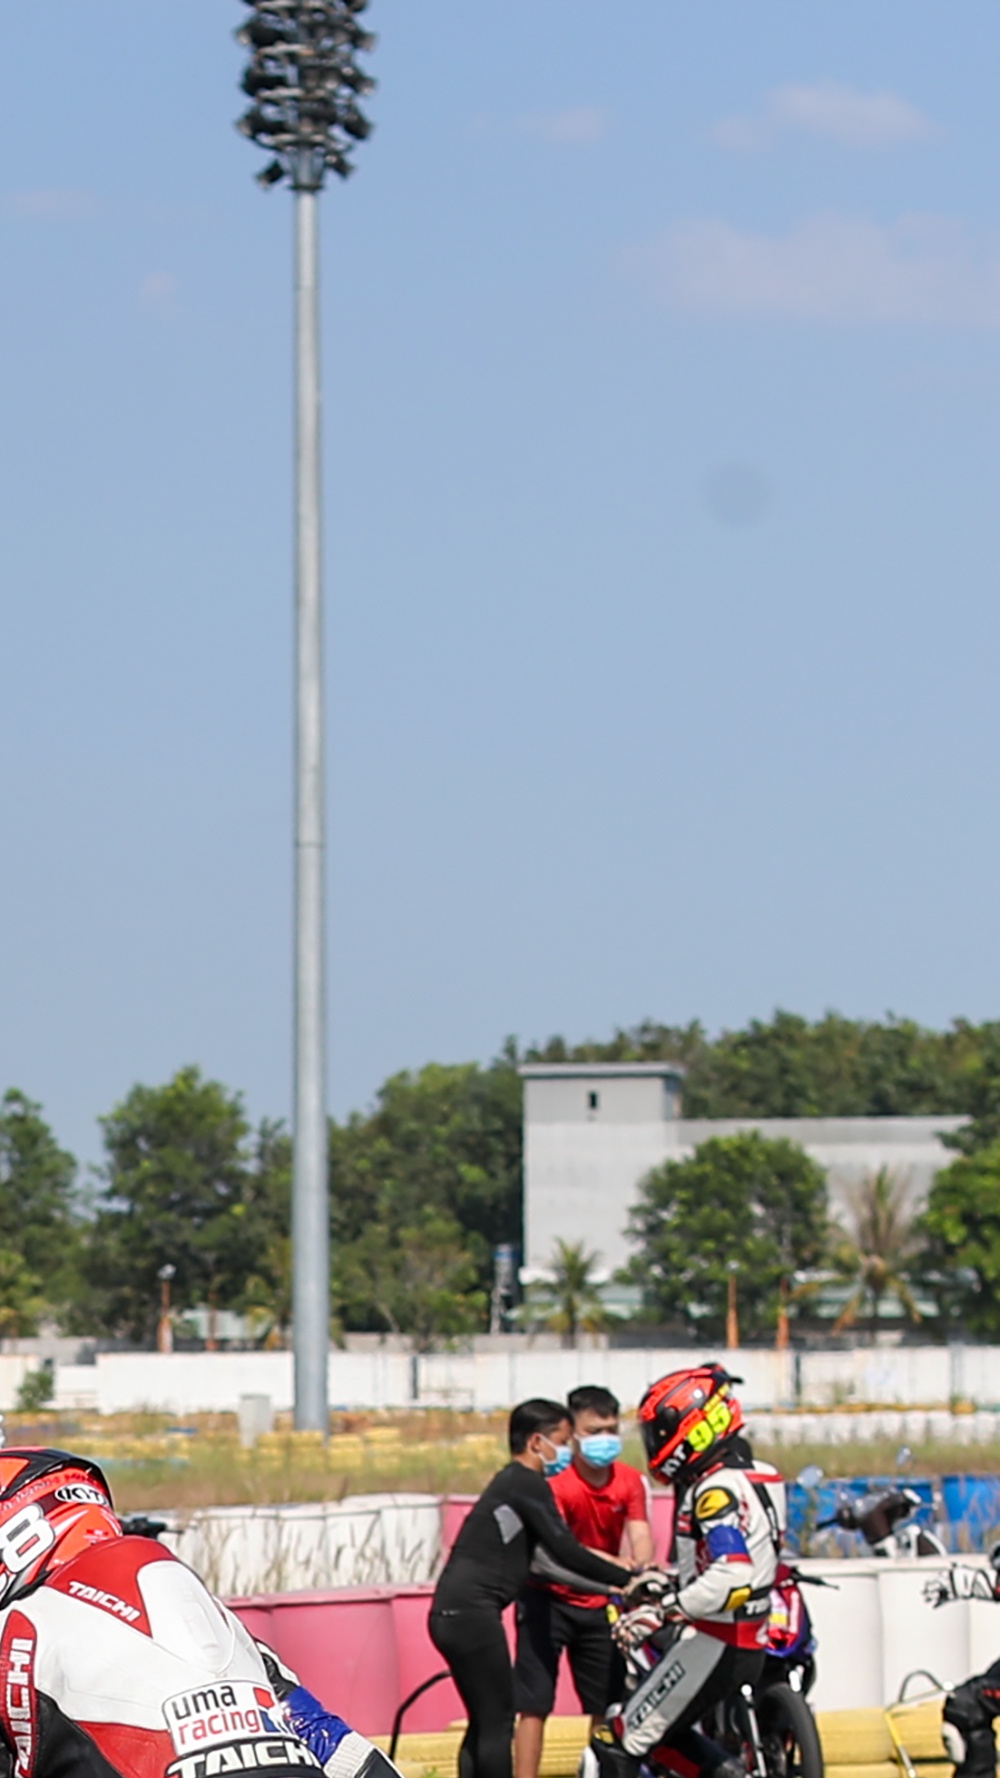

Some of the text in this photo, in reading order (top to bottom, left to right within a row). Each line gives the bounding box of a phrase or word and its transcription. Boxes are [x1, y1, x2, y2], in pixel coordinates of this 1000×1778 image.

[687, 1401, 732, 1453] 95
[57, 1485, 103, 1502] KYT
[68, 1581, 141, 1622] TAICHI
[172, 1685, 237, 1720] uma
[627, 1660, 687, 1731] TAICHI
[178, 1706, 261, 1746] racing
